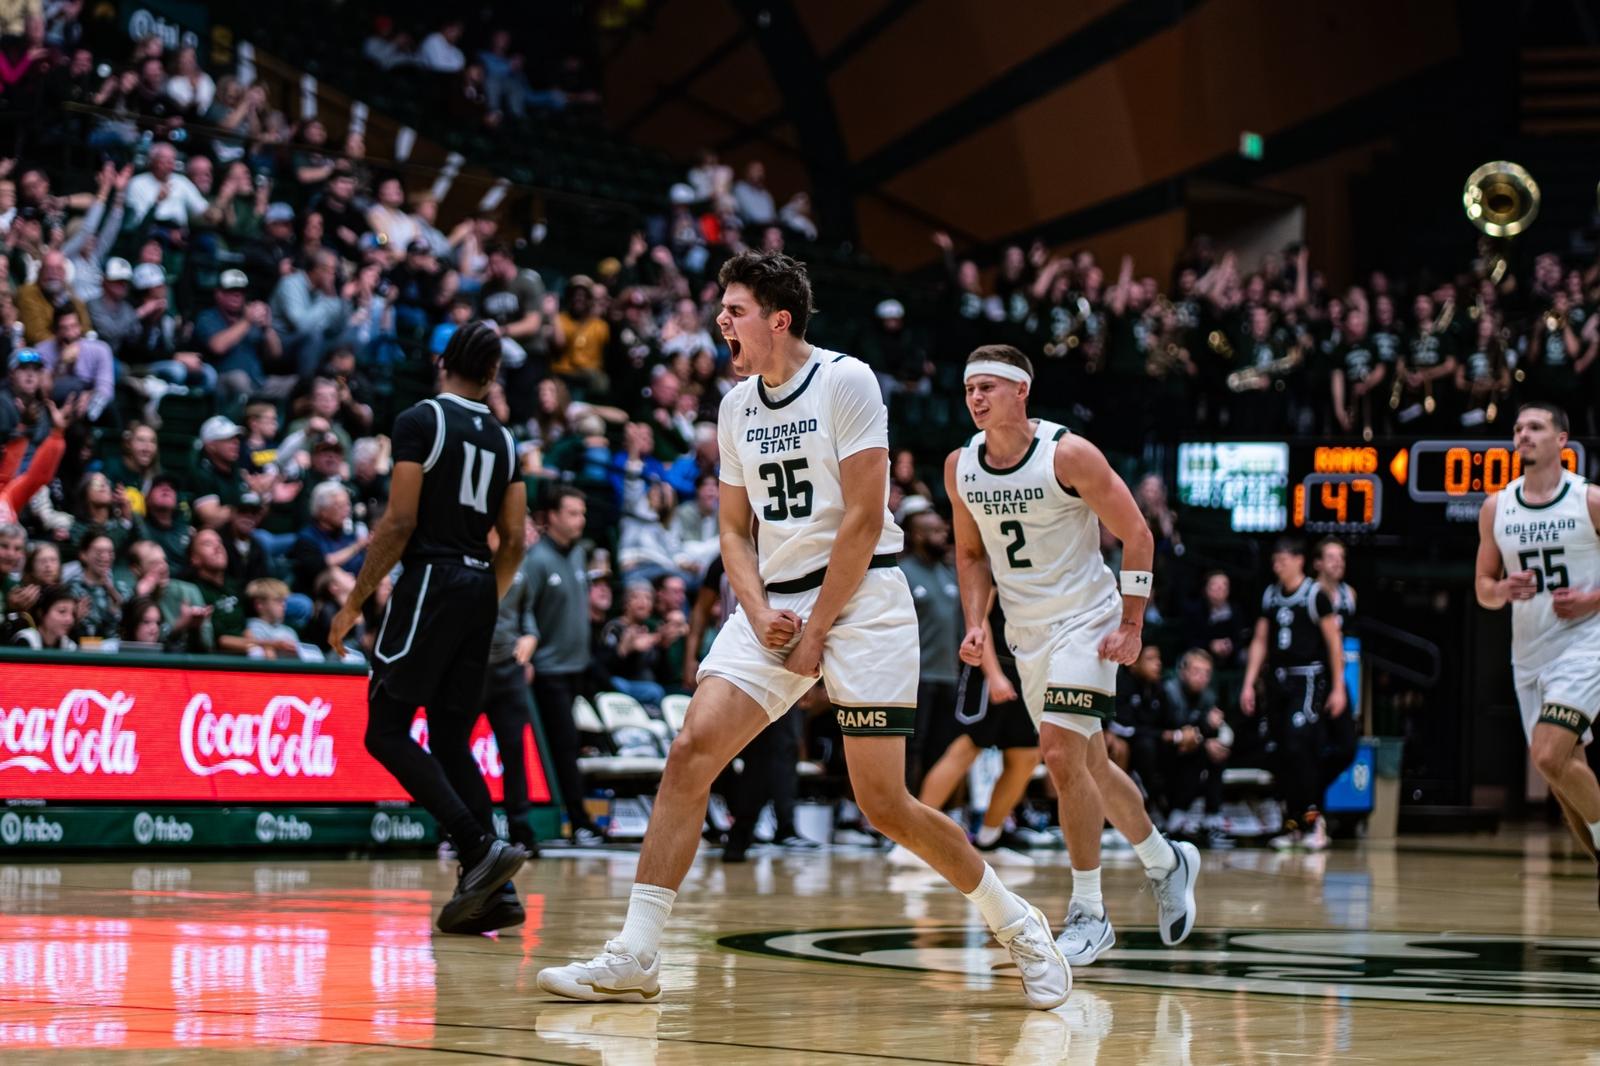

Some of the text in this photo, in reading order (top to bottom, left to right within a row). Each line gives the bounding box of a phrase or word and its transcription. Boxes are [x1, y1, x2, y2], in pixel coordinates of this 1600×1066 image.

[746, 418, 818, 442] COLORADO
[760, 436, 801, 454] STATE
[459, 440, 496, 514] 11
[758, 457, 814, 522] 35
[967, 487, 1044, 503] COLORADO
[983, 502, 1028, 515] STATE
[1505, 518, 1576, 535] COLORADO
[1000, 520, 1033, 568] 2
[1519, 530, 1560, 543] STATE
[1518, 545, 1570, 594] 55
[1043, 690, 1093, 708] RAMS
[836, 709, 888, 727] RAMS
[179, 693, 338, 777] Coca-Cola
